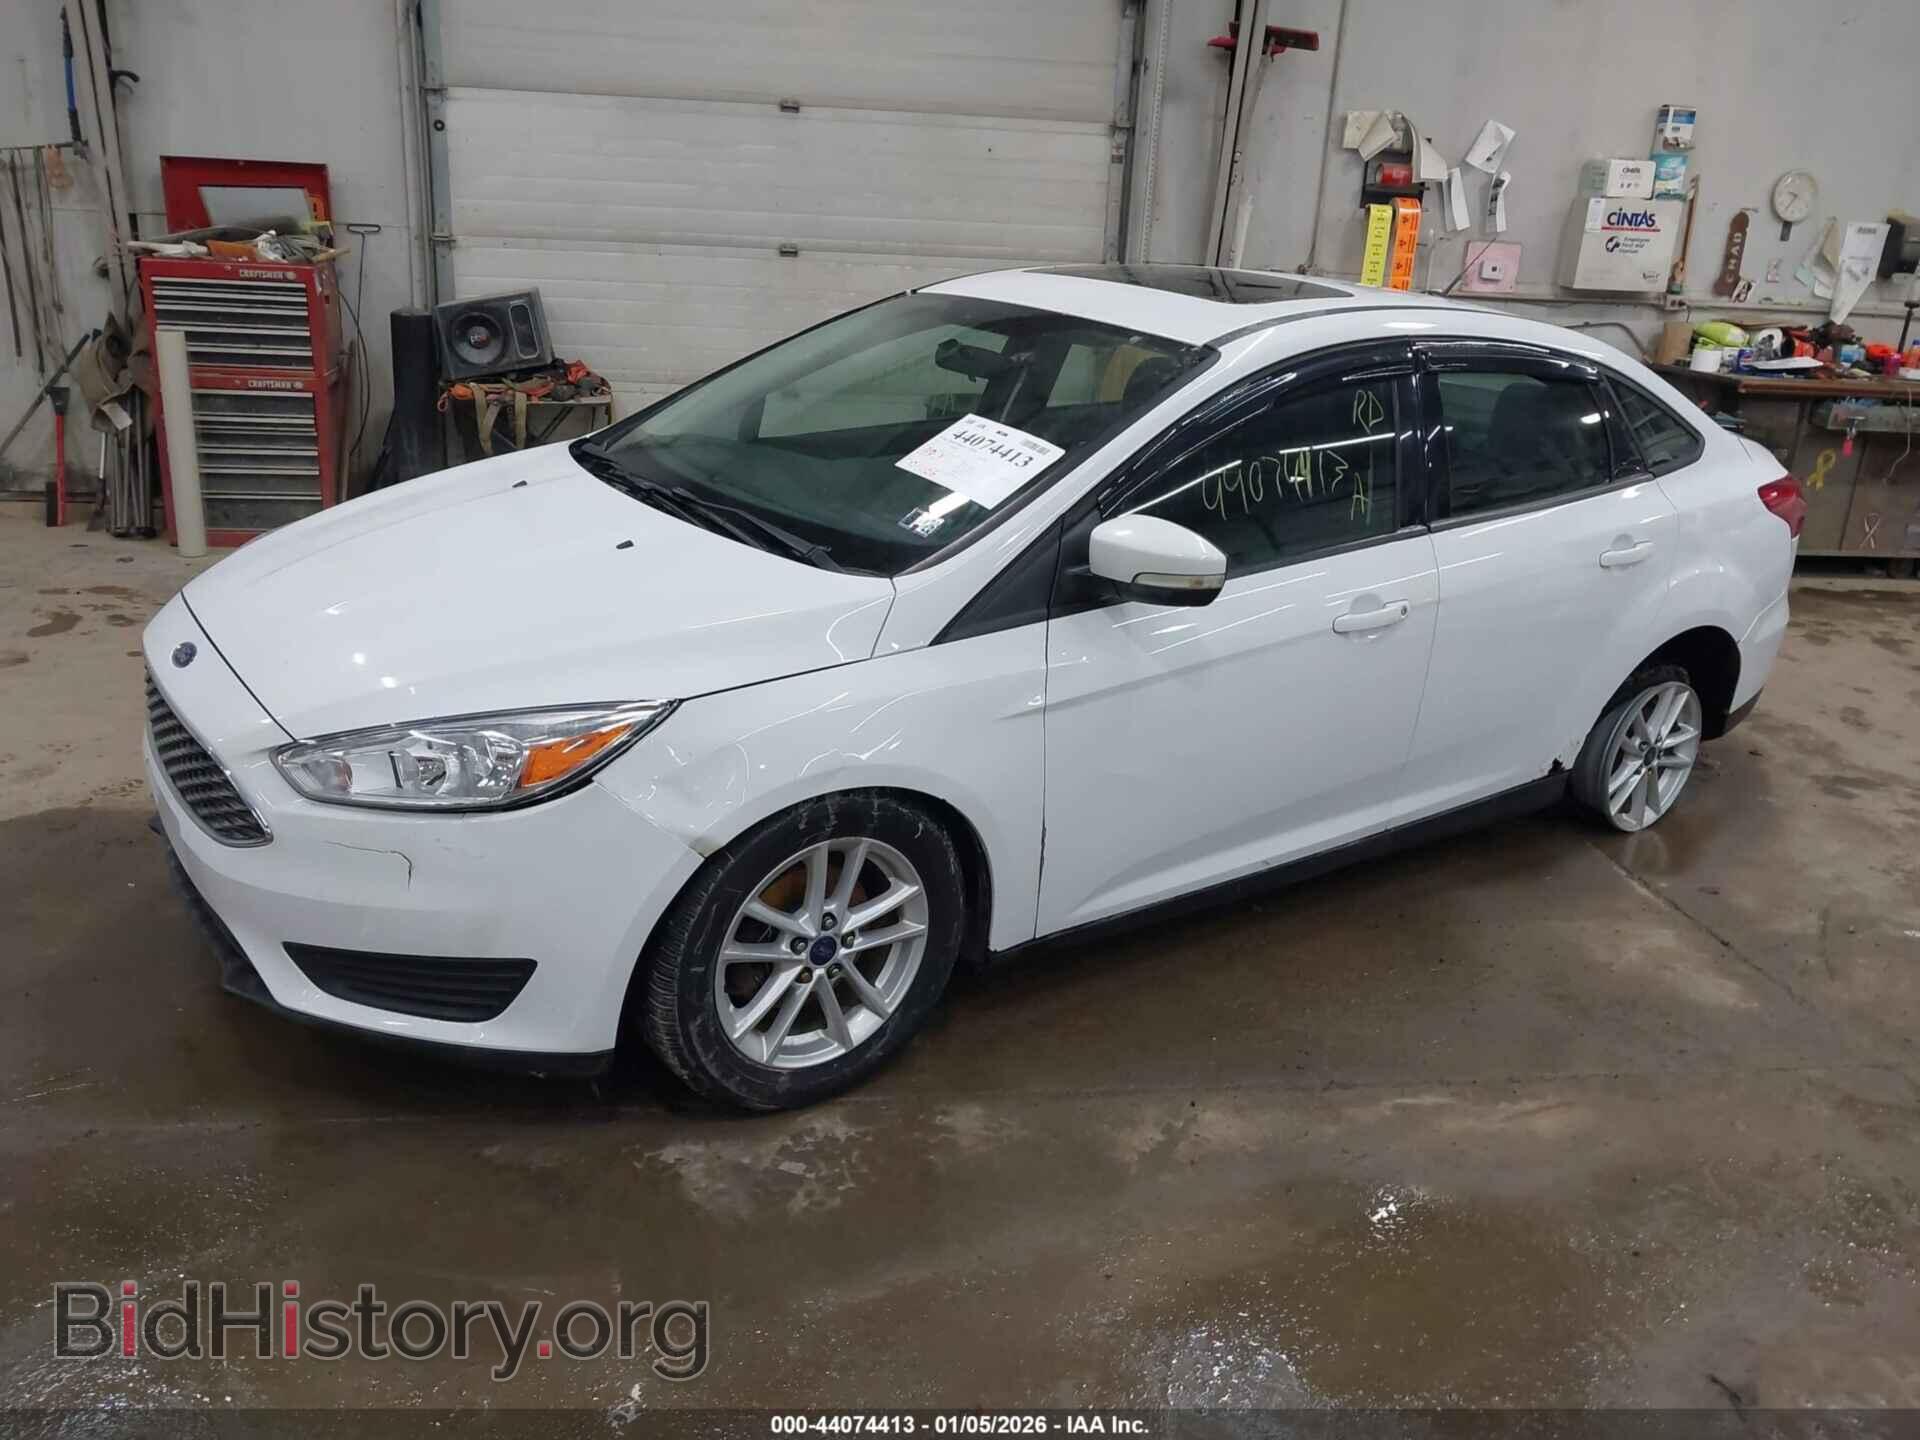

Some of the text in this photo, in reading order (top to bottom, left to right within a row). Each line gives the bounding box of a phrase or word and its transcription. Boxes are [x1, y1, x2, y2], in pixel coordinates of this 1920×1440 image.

[1607, 207, 1656, 228] CINTAS
[1726, 232, 1743, 283] CHAD
[239, 270, 283, 280] CRAFTSMAN
[248, 380, 292, 390] CRAFTSMAN
[953, 430, 1034, 468] 44074413
